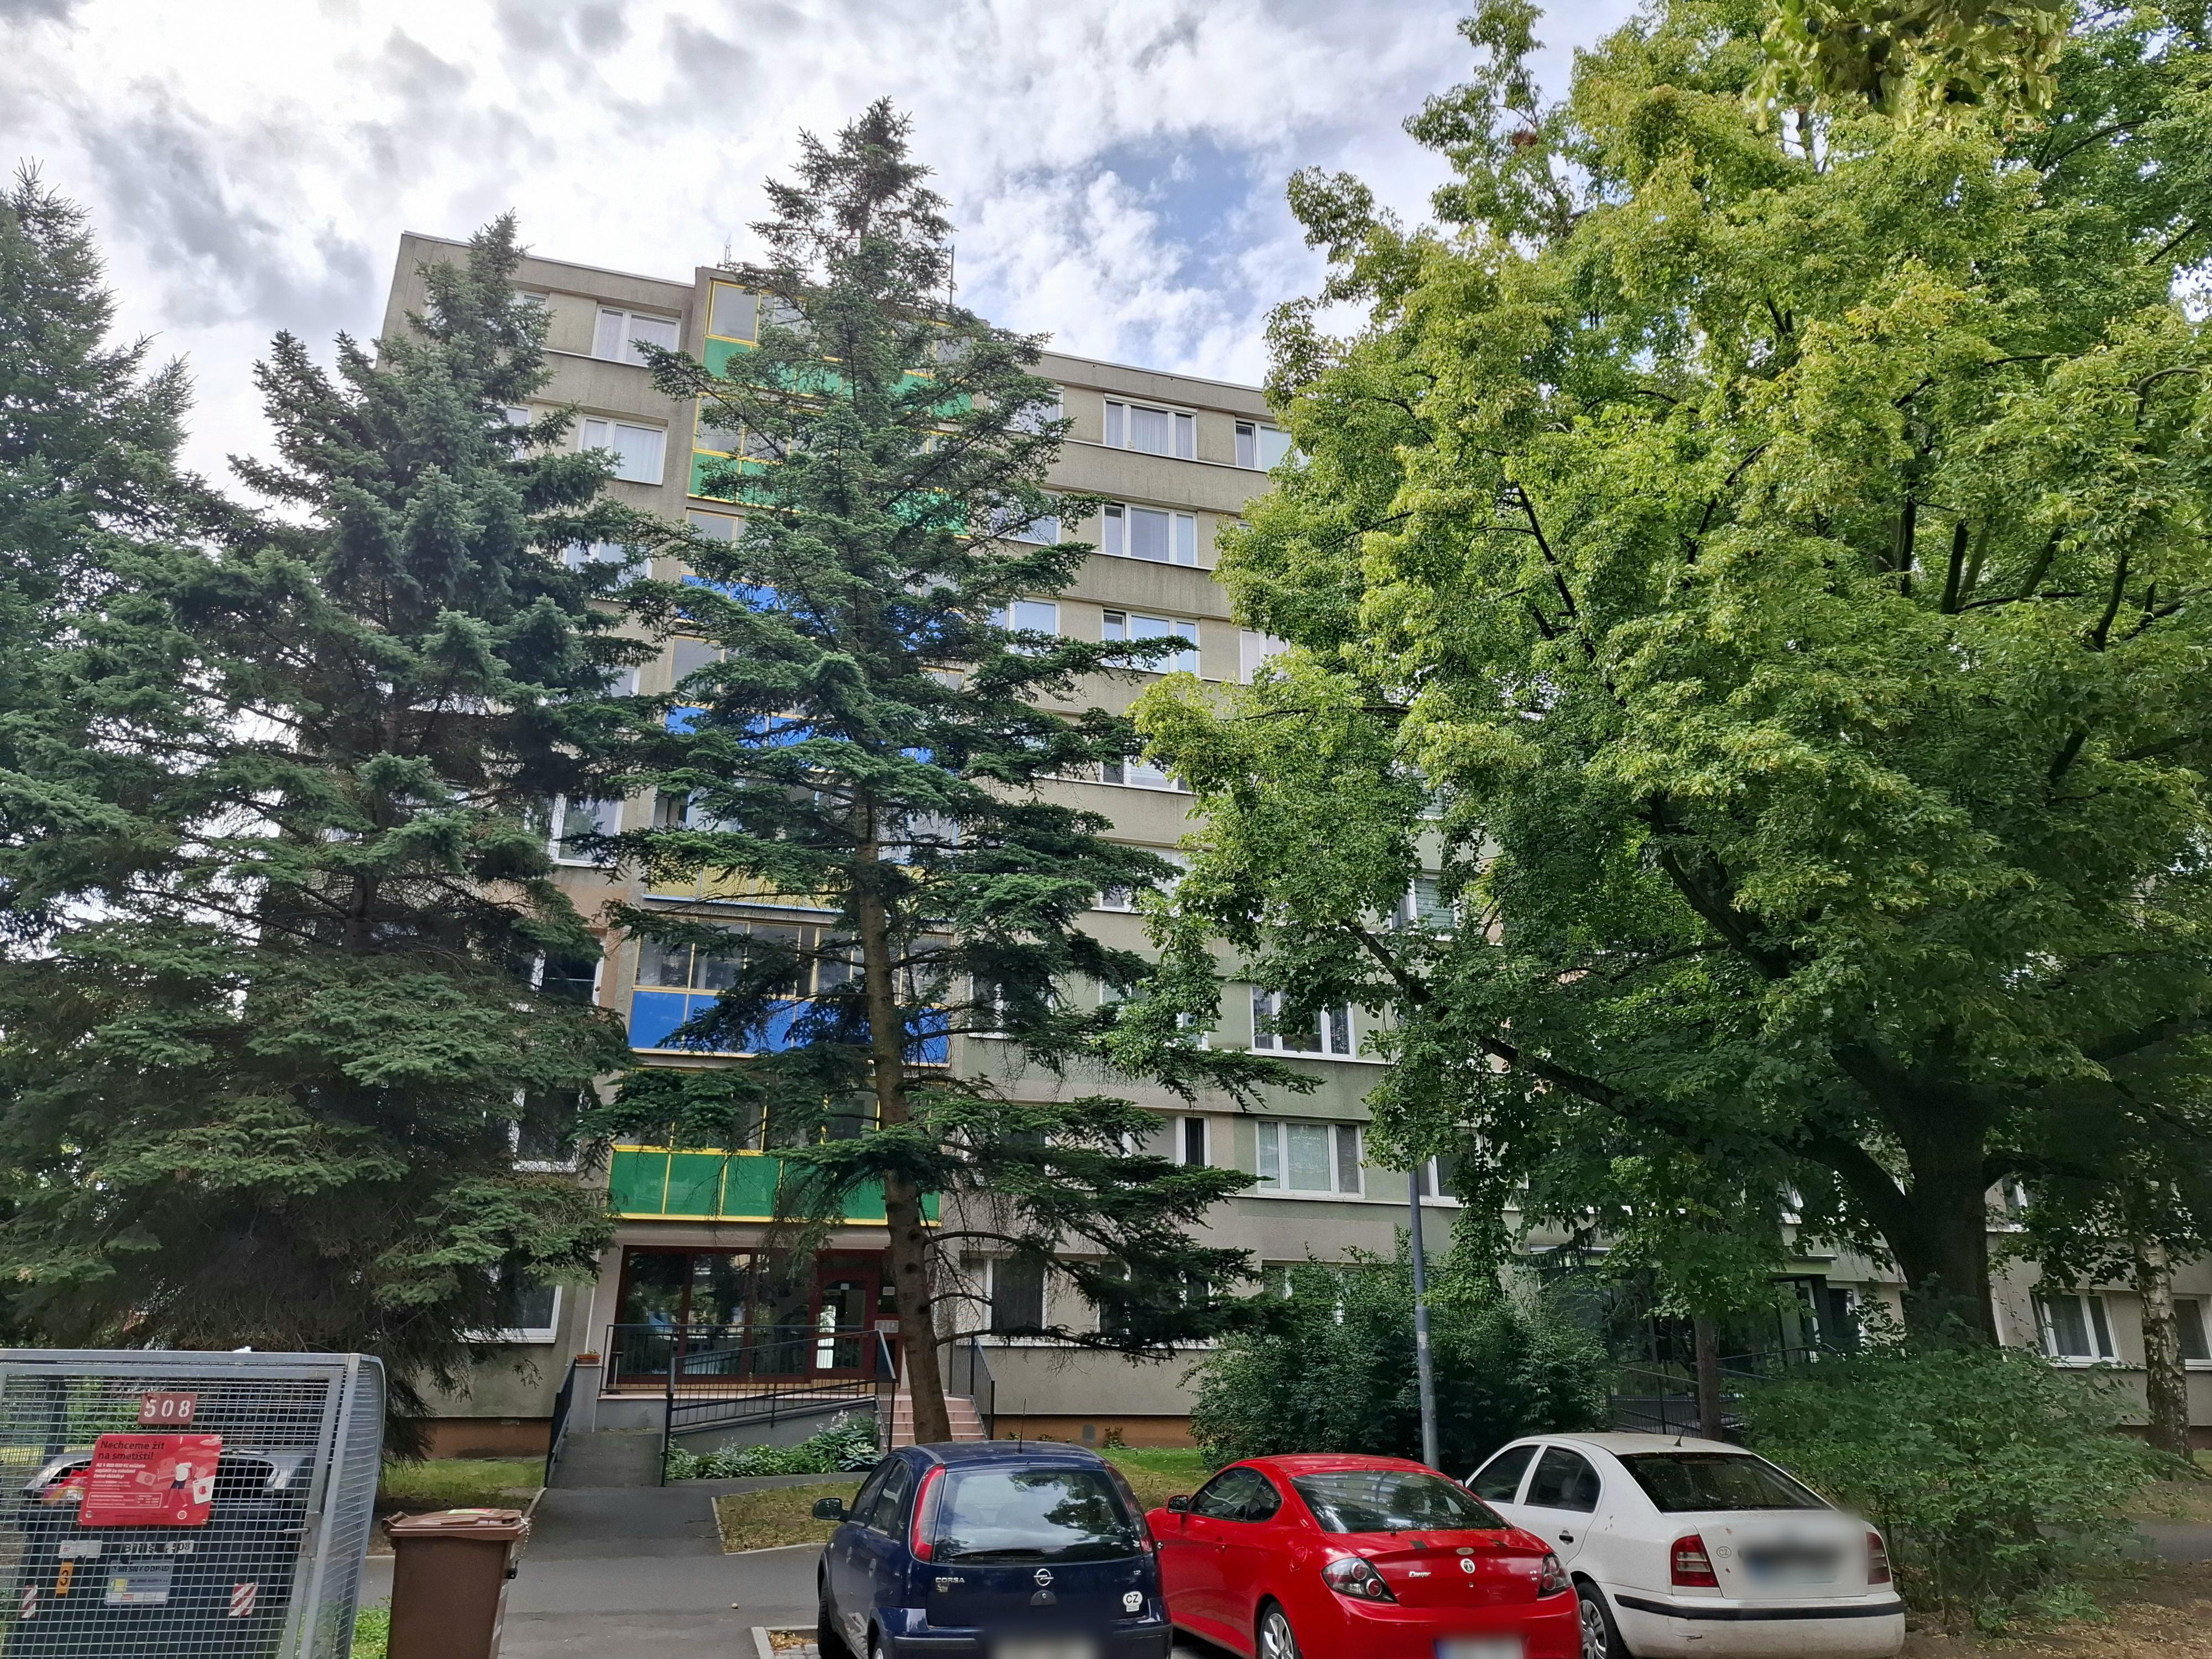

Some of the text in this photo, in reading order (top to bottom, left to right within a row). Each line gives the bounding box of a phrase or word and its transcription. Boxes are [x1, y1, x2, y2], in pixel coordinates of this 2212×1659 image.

[144, 1400, 190, 1417] 508
[101, 1441, 165, 1449] Nechceme žít
[112, 1452, 154, 1460] smetišti!
[1126, 1594, 1139, 1604] CZ
